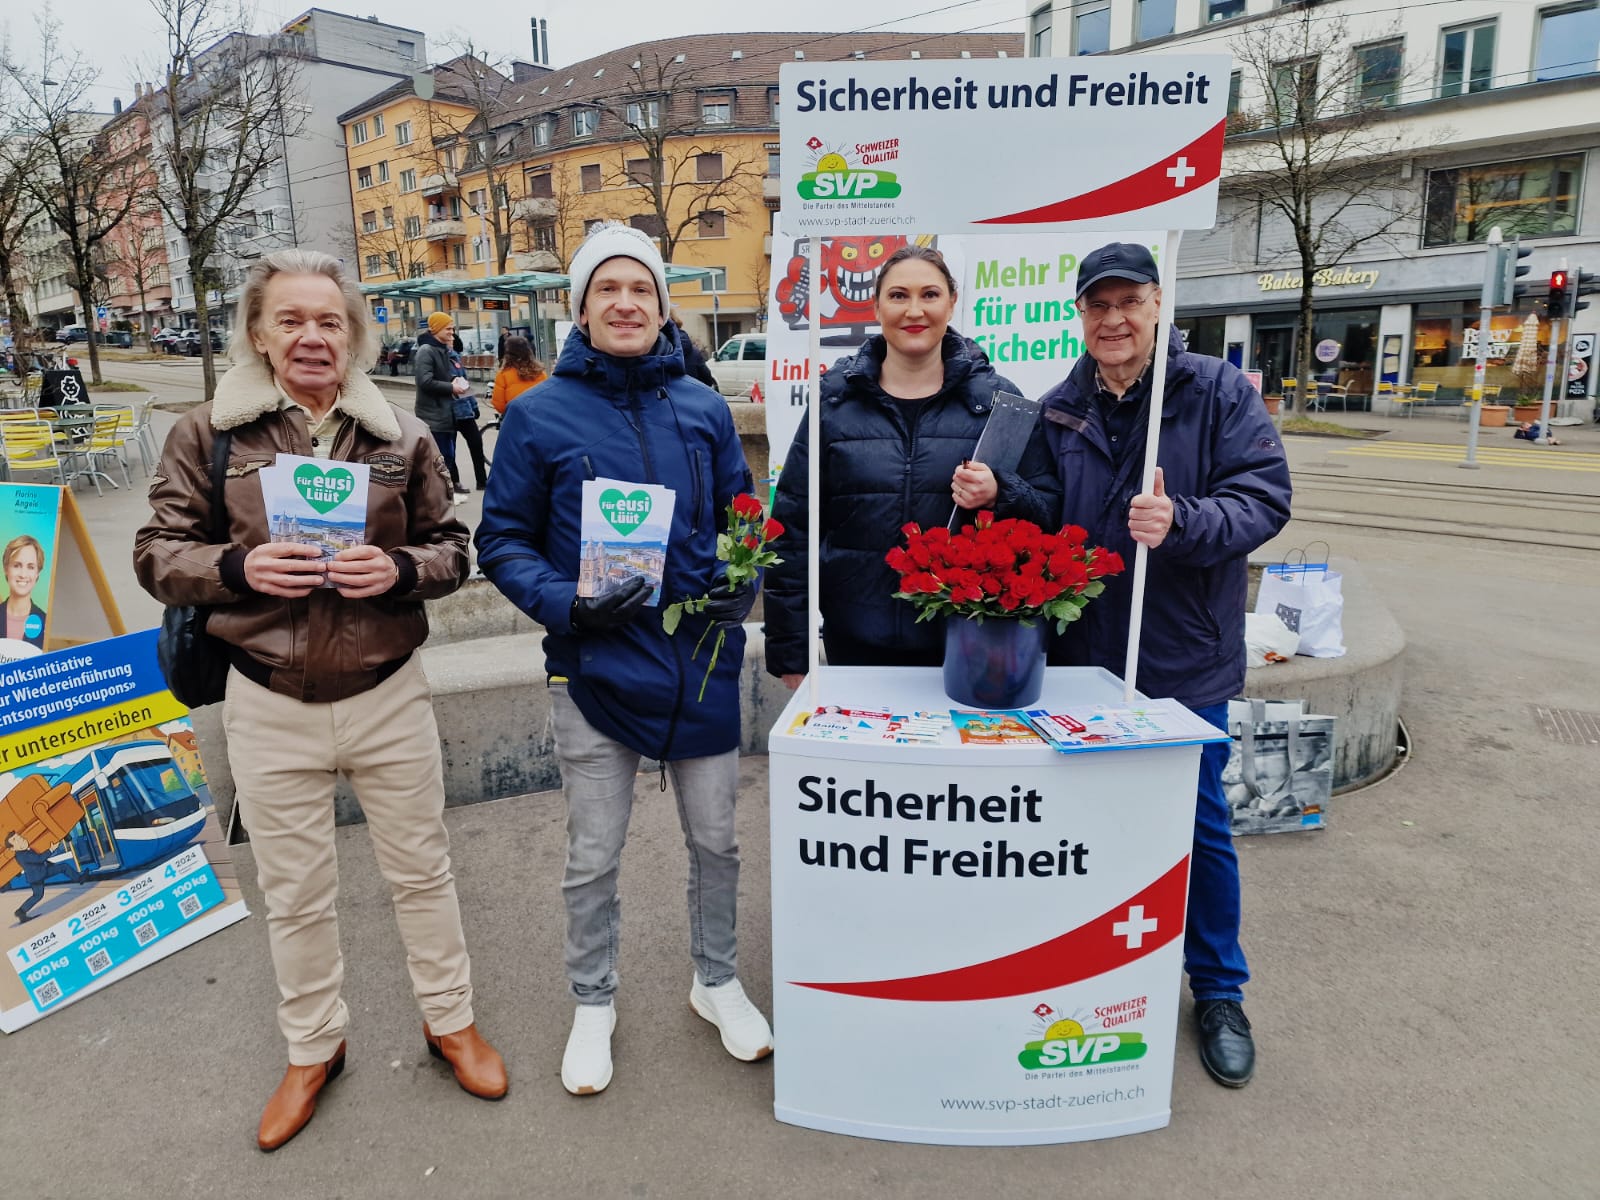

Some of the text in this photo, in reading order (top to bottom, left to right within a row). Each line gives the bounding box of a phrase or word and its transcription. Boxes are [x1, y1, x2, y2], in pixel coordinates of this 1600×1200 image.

[797, 71, 1210, 112] Sicherheit und Freiheit
[813, 172, 879, 197] SVP
[850, 201, 896, 209] Mittelstandes
[798, 216, 916, 227] www.svp-stadt-zuerich.ch
[975, 257, 1050, 289] Mehr
[1312, 266, 1379, 290] Bakery
[973, 296, 1081, 326] für uns
[296, 475, 353, 492] Für eusi
[306, 487, 340, 503] Lüüt
[601, 496, 650, 512] Für eusi
[610, 511, 640, 525] Lüüt
[12, 663, 133, 703] Wiedereinführung
[15, 706, 152, 758] unterschreiben
[797, 775, 1042, 823] Sicherheit
[164, 864, 177, 879] 4
[175, 852, 196, 867] 2024
[799, 834, 1089, 878] und Freiheit
[116, 890, 133, 906] 3
[130, 876, 153, 893] 2024
[171, 881, 192, 898] 100
[191, 874, 208, 887] kg
[67, 917, 86, 937] 2
[82, 903, 107, 921] 2024
[126, 907, 148, 925] 100
[147, 899, 165, 913] kg
[16, 947, 31, 963] 1
[30, 932, 57, 950] 2024
[78, 926, 119, 953] 100 kg
[26, 956, 70, 984] 100 kg
[1094, 996, 1147, 1019] SCHWEIZER
[1102, 1007, 1147, 1029] QUALITÄT
[1038, 1035, 1121, 1066] SVP
[1025, 1064, 1140, 1081] Die Partei des Mittelstandes
[940, 1085, 1145, 1112] www.svp-stadt-zuerich.ch
